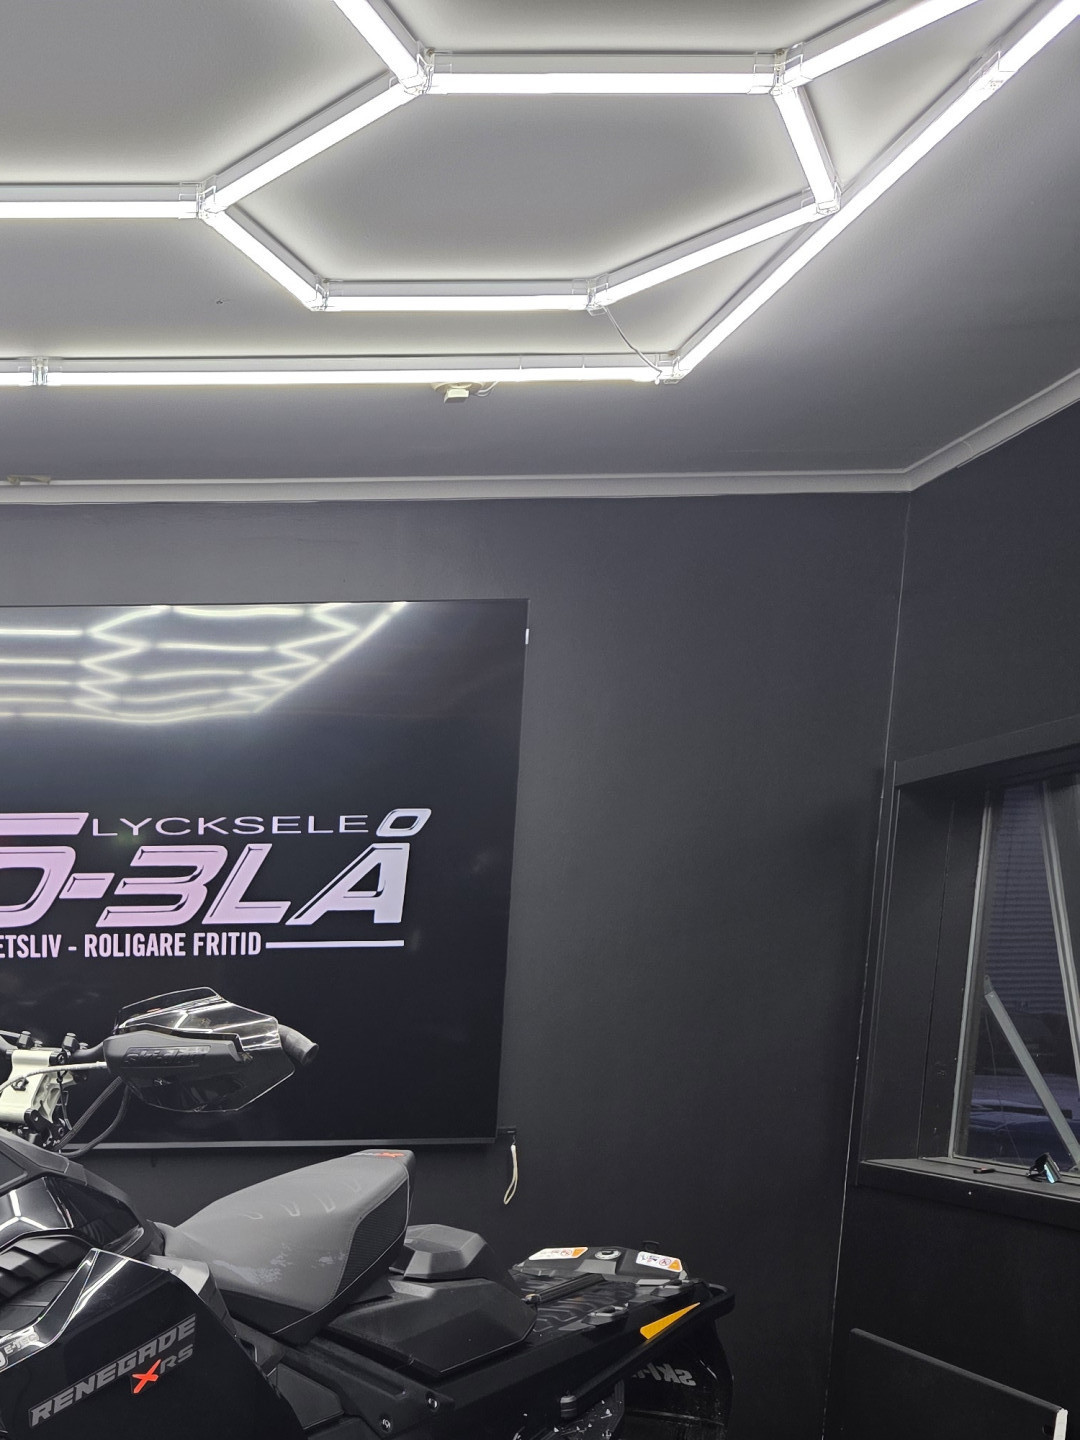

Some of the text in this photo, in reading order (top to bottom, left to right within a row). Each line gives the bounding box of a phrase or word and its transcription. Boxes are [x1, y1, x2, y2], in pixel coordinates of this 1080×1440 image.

[92, 814, 369, 837] LYCKSELE
[84, 932, 187, 958] ROLIGARE
[192, 931, 262, 957] FRITID
[30, 1315, 197, 1427] RENEGADE
